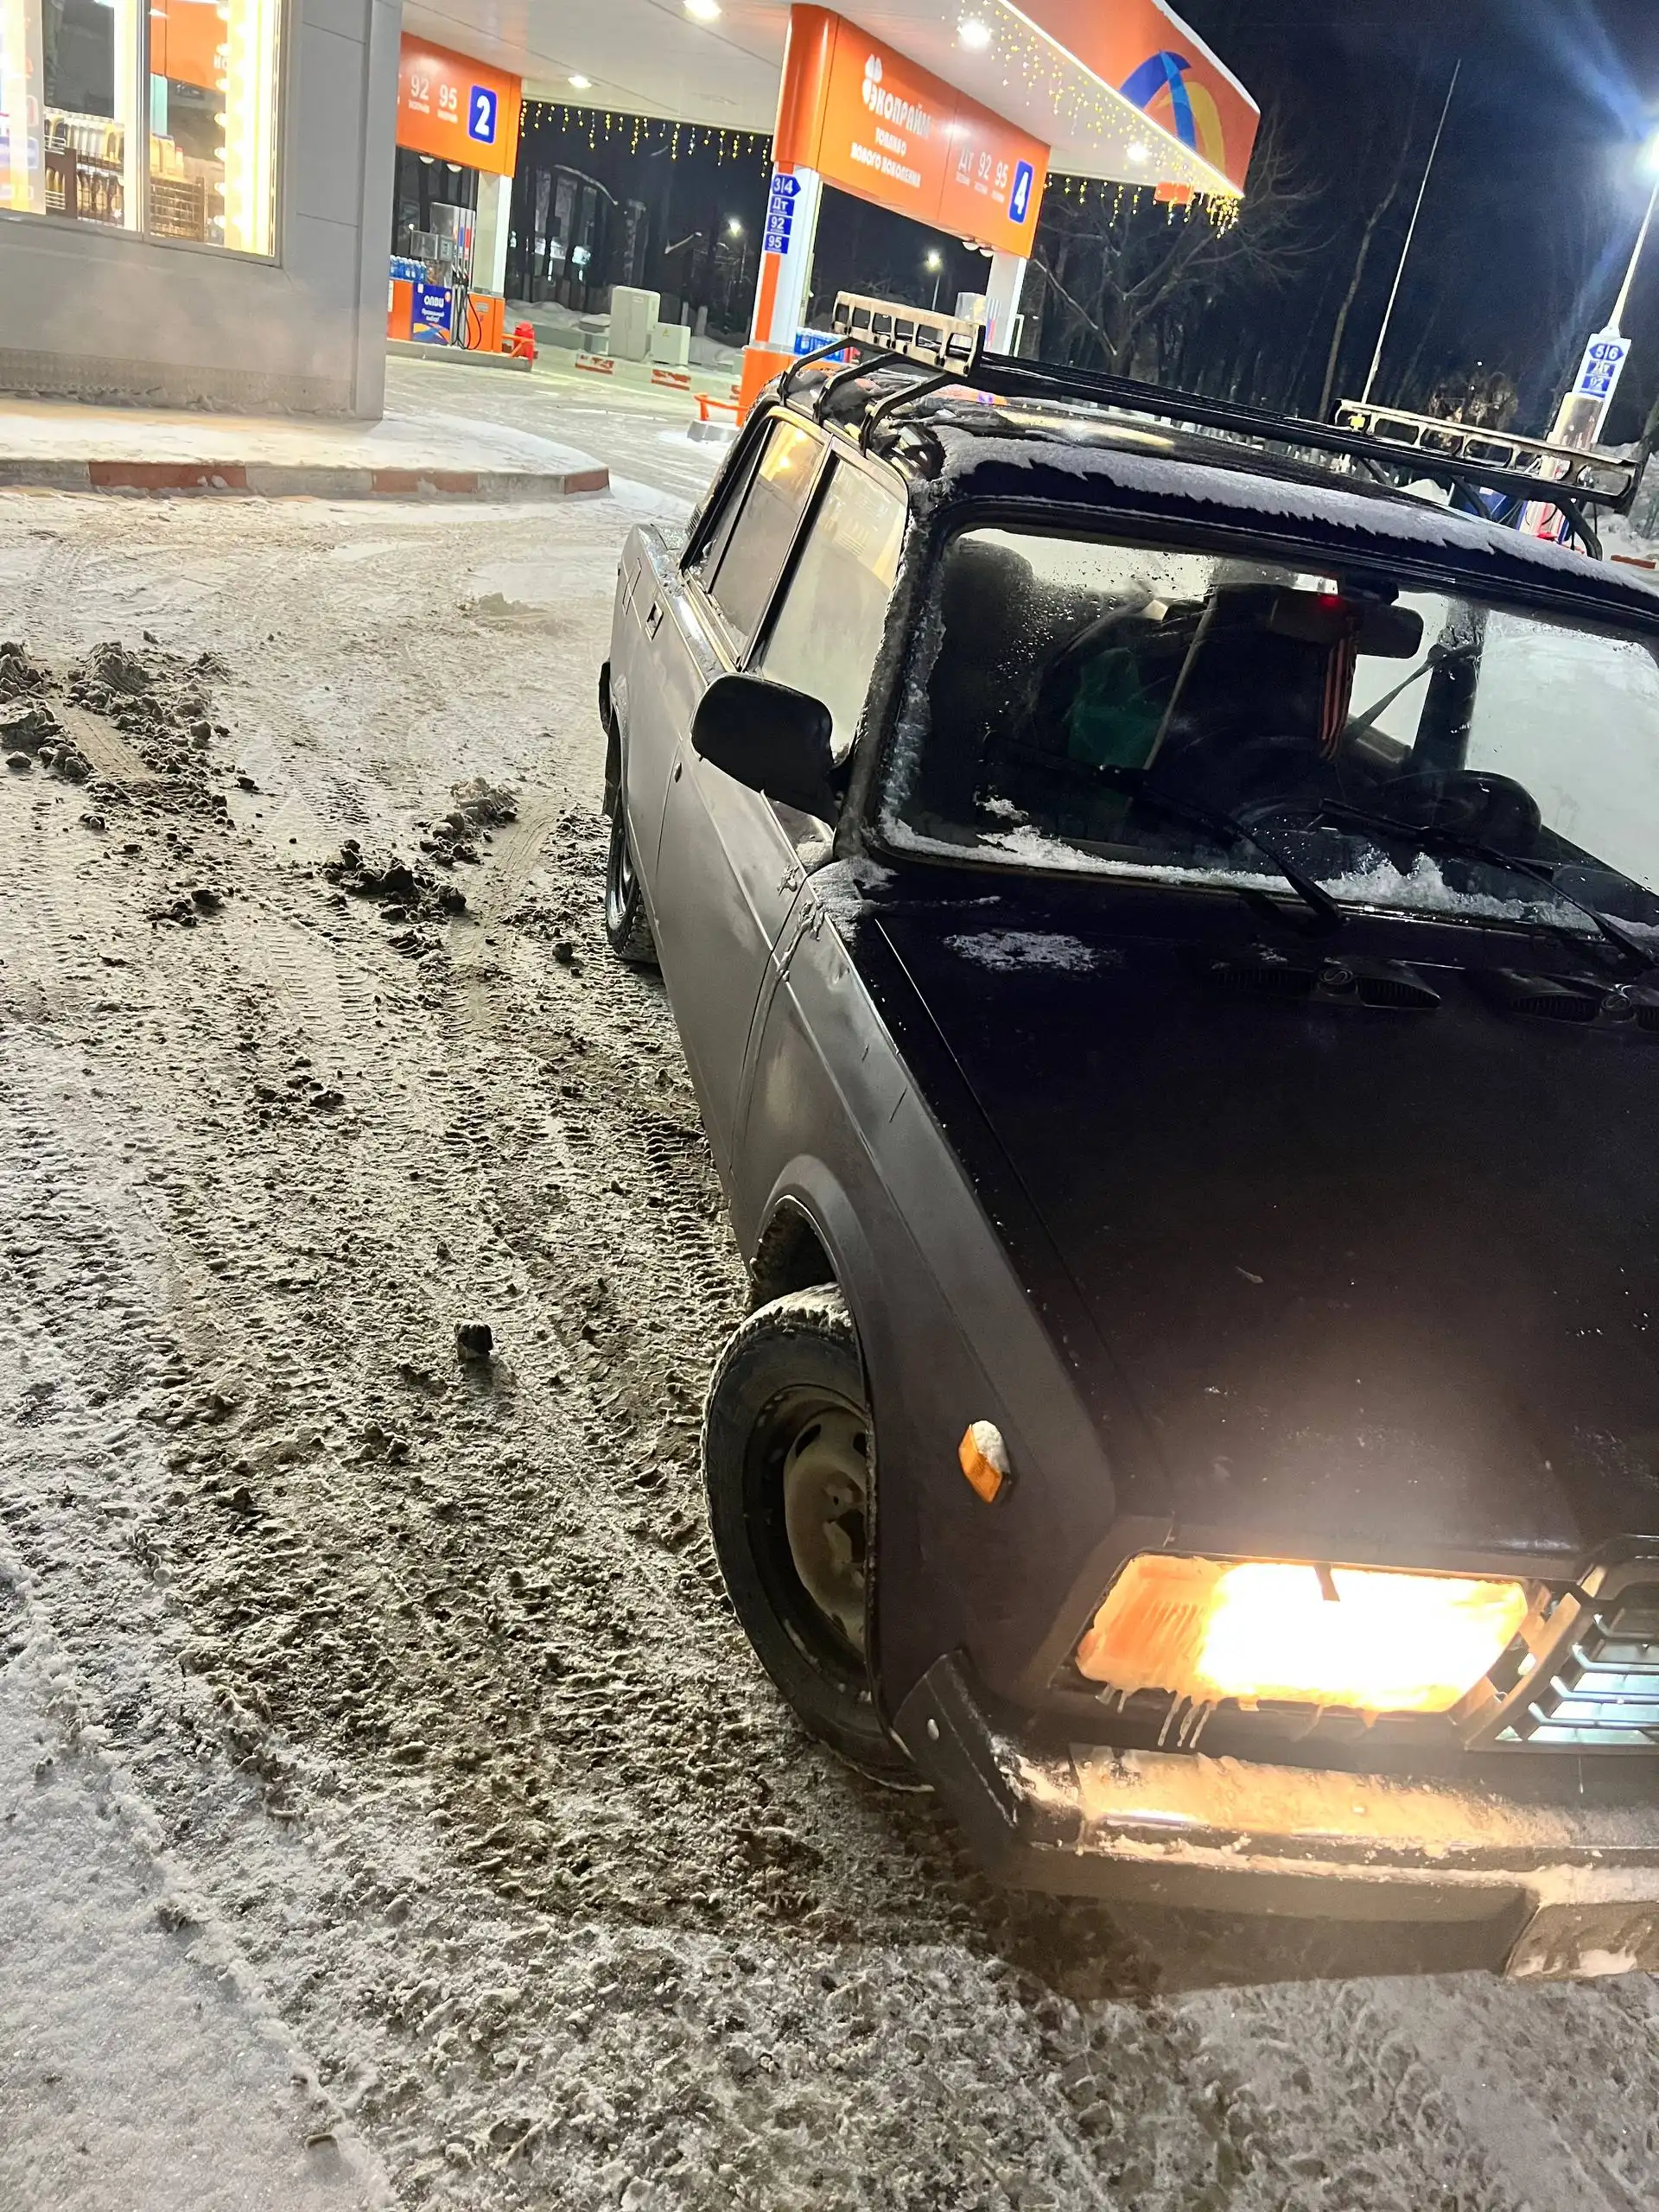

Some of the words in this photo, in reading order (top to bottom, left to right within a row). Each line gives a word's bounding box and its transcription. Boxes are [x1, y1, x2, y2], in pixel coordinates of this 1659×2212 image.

[410, 74, 429, 100] 92
[439, 84, 457, 111] 95
[474, 95, 491, 137] 2
[977, 152, 992, 180] 92
[995, 161, 1008, 188] 95
[1014, 172, 1028, 215] 4
[771, 216, 785, 229] 92
[768, 235, 782, 248] 95
